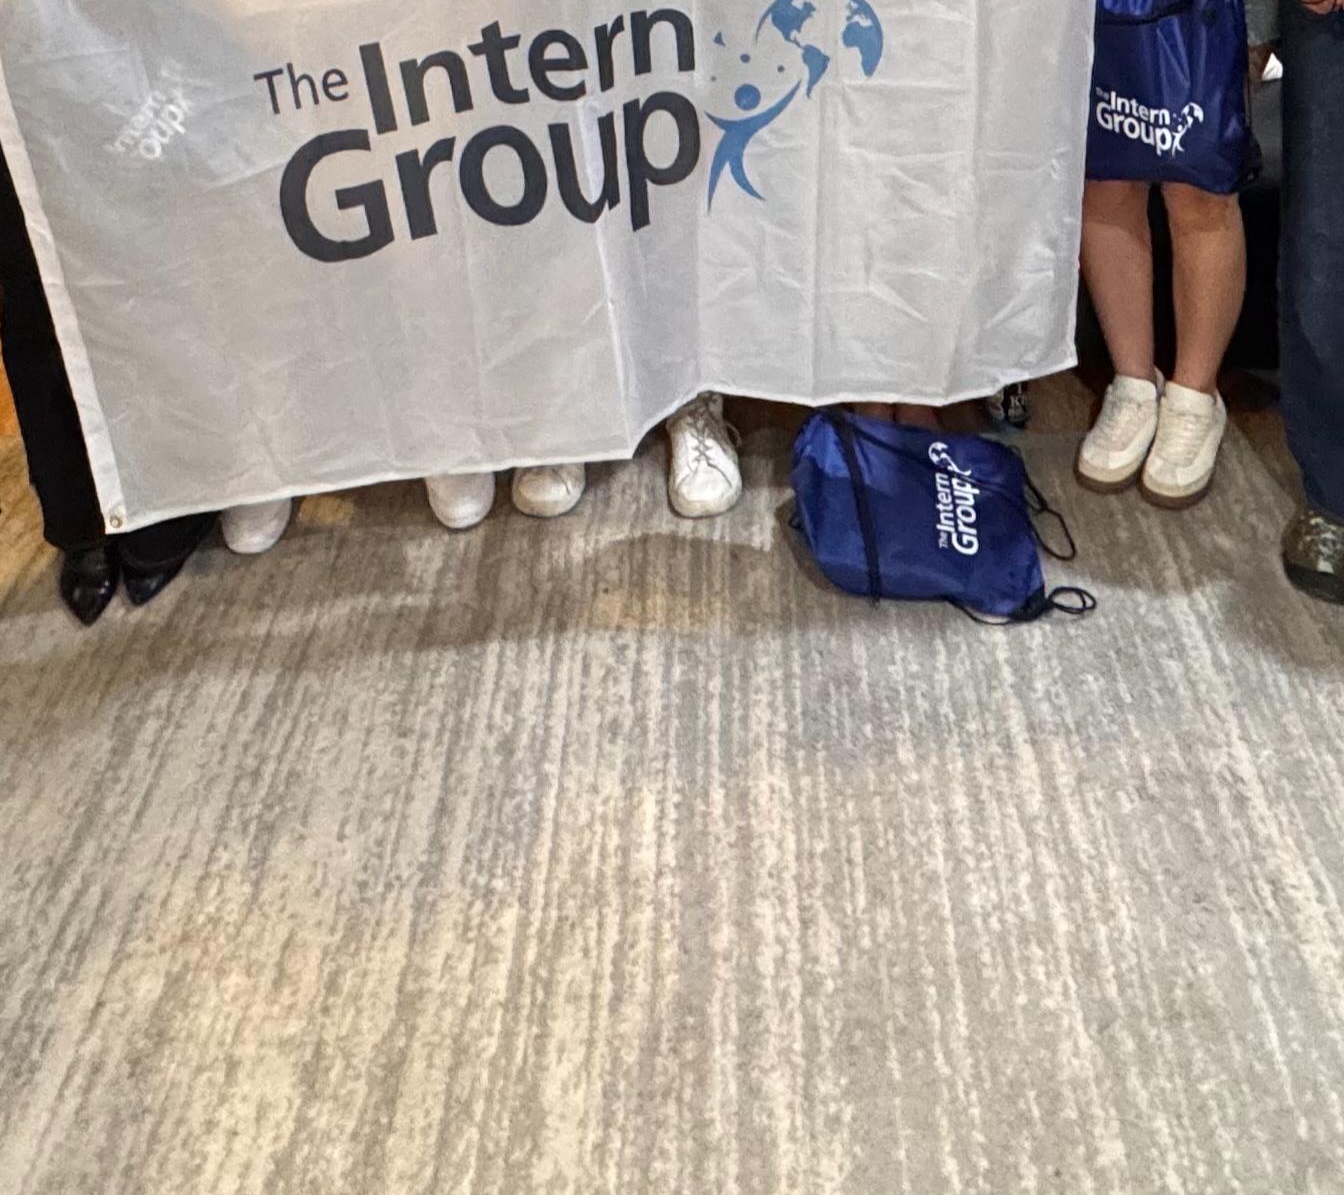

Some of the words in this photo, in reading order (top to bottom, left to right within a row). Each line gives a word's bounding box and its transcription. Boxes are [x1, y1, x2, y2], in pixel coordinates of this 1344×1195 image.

[254, 63, 349, 114] The
[360, 8, 696, 135] Intern
[1096, 102, 1173, 156] Group
[1110, 91, 1171, 126] Intern
[280, 92, 701, 263] Group
[935, 472, 955, 534] Intern
[951, 477, 981, 556] Group
[938, 531, 948, 549] The
